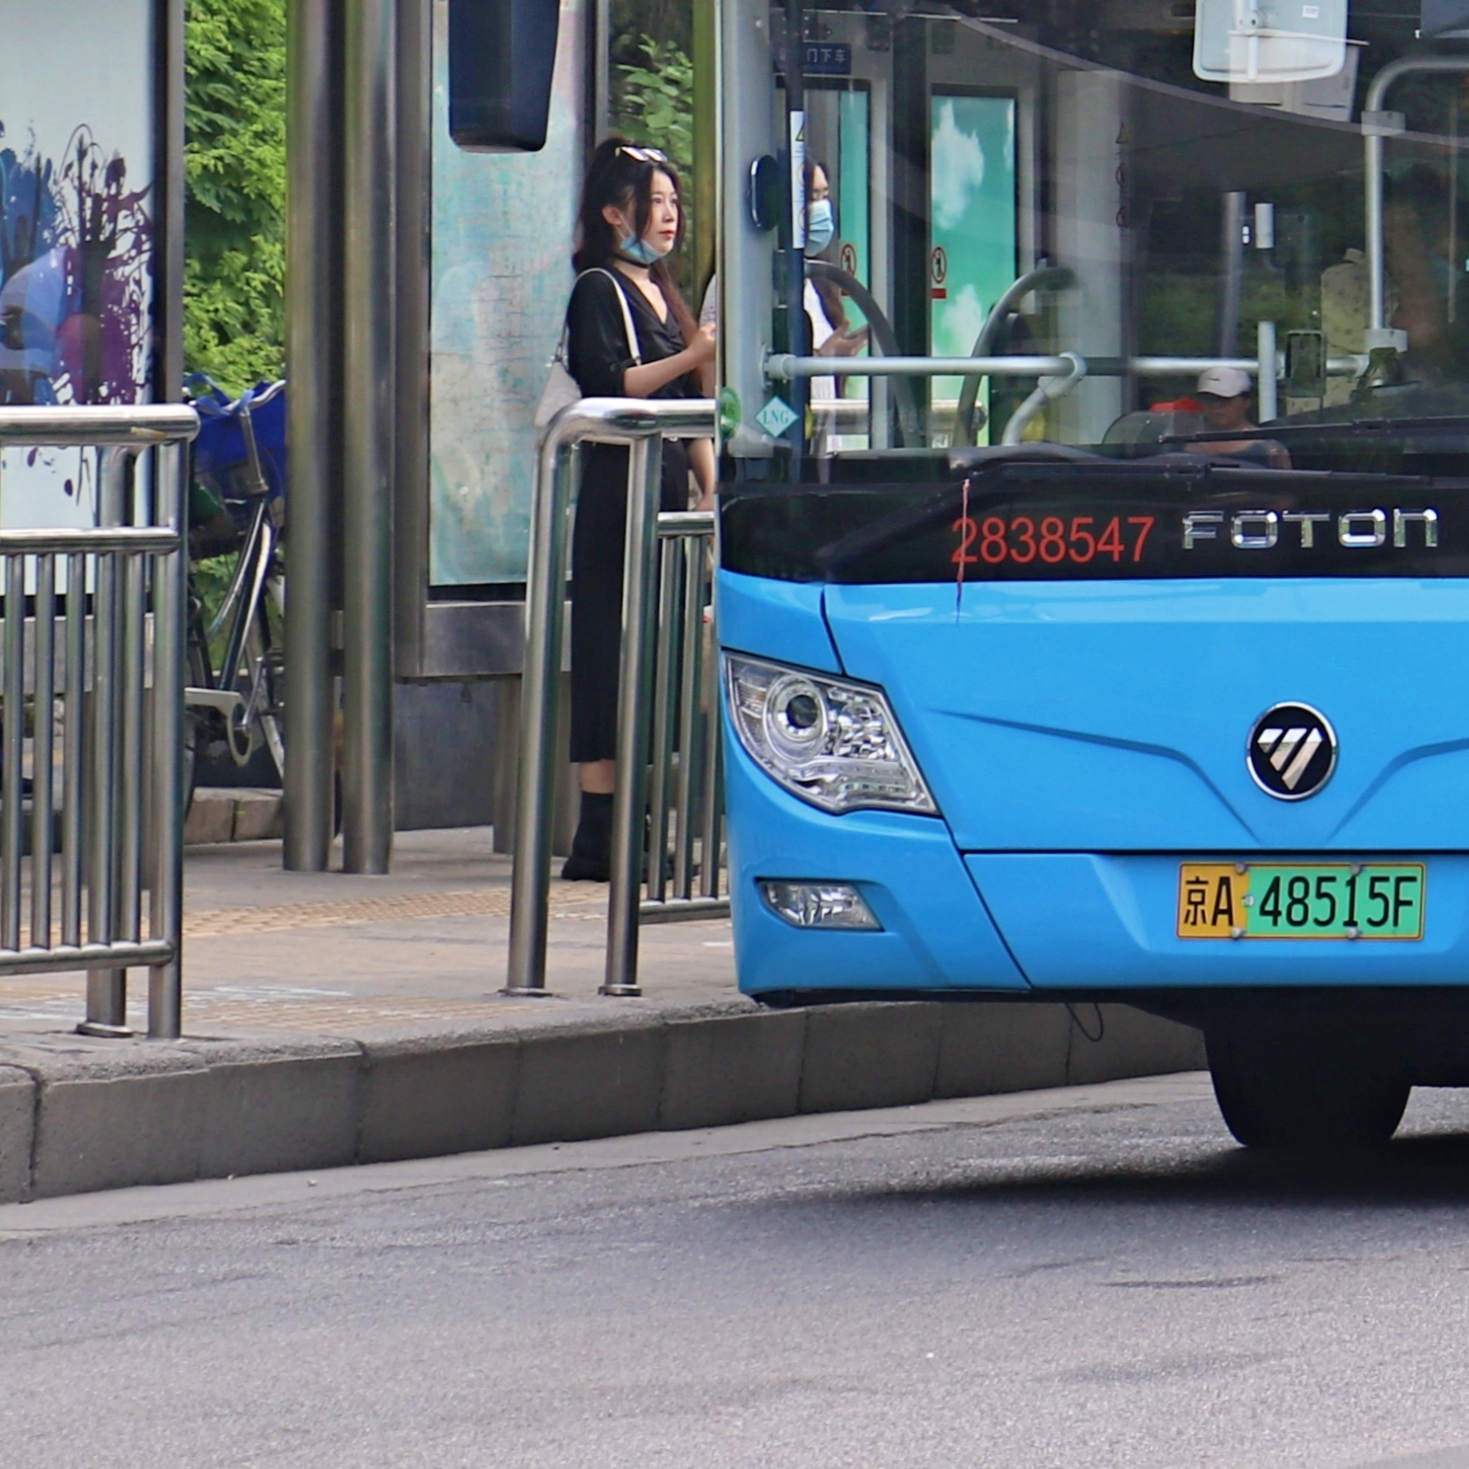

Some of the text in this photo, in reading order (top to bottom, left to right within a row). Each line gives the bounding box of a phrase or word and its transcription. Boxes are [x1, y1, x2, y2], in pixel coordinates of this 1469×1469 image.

[763, 410, 790, 425] LNG
[951, 509, 1438, 563] 2838547 FOTON
